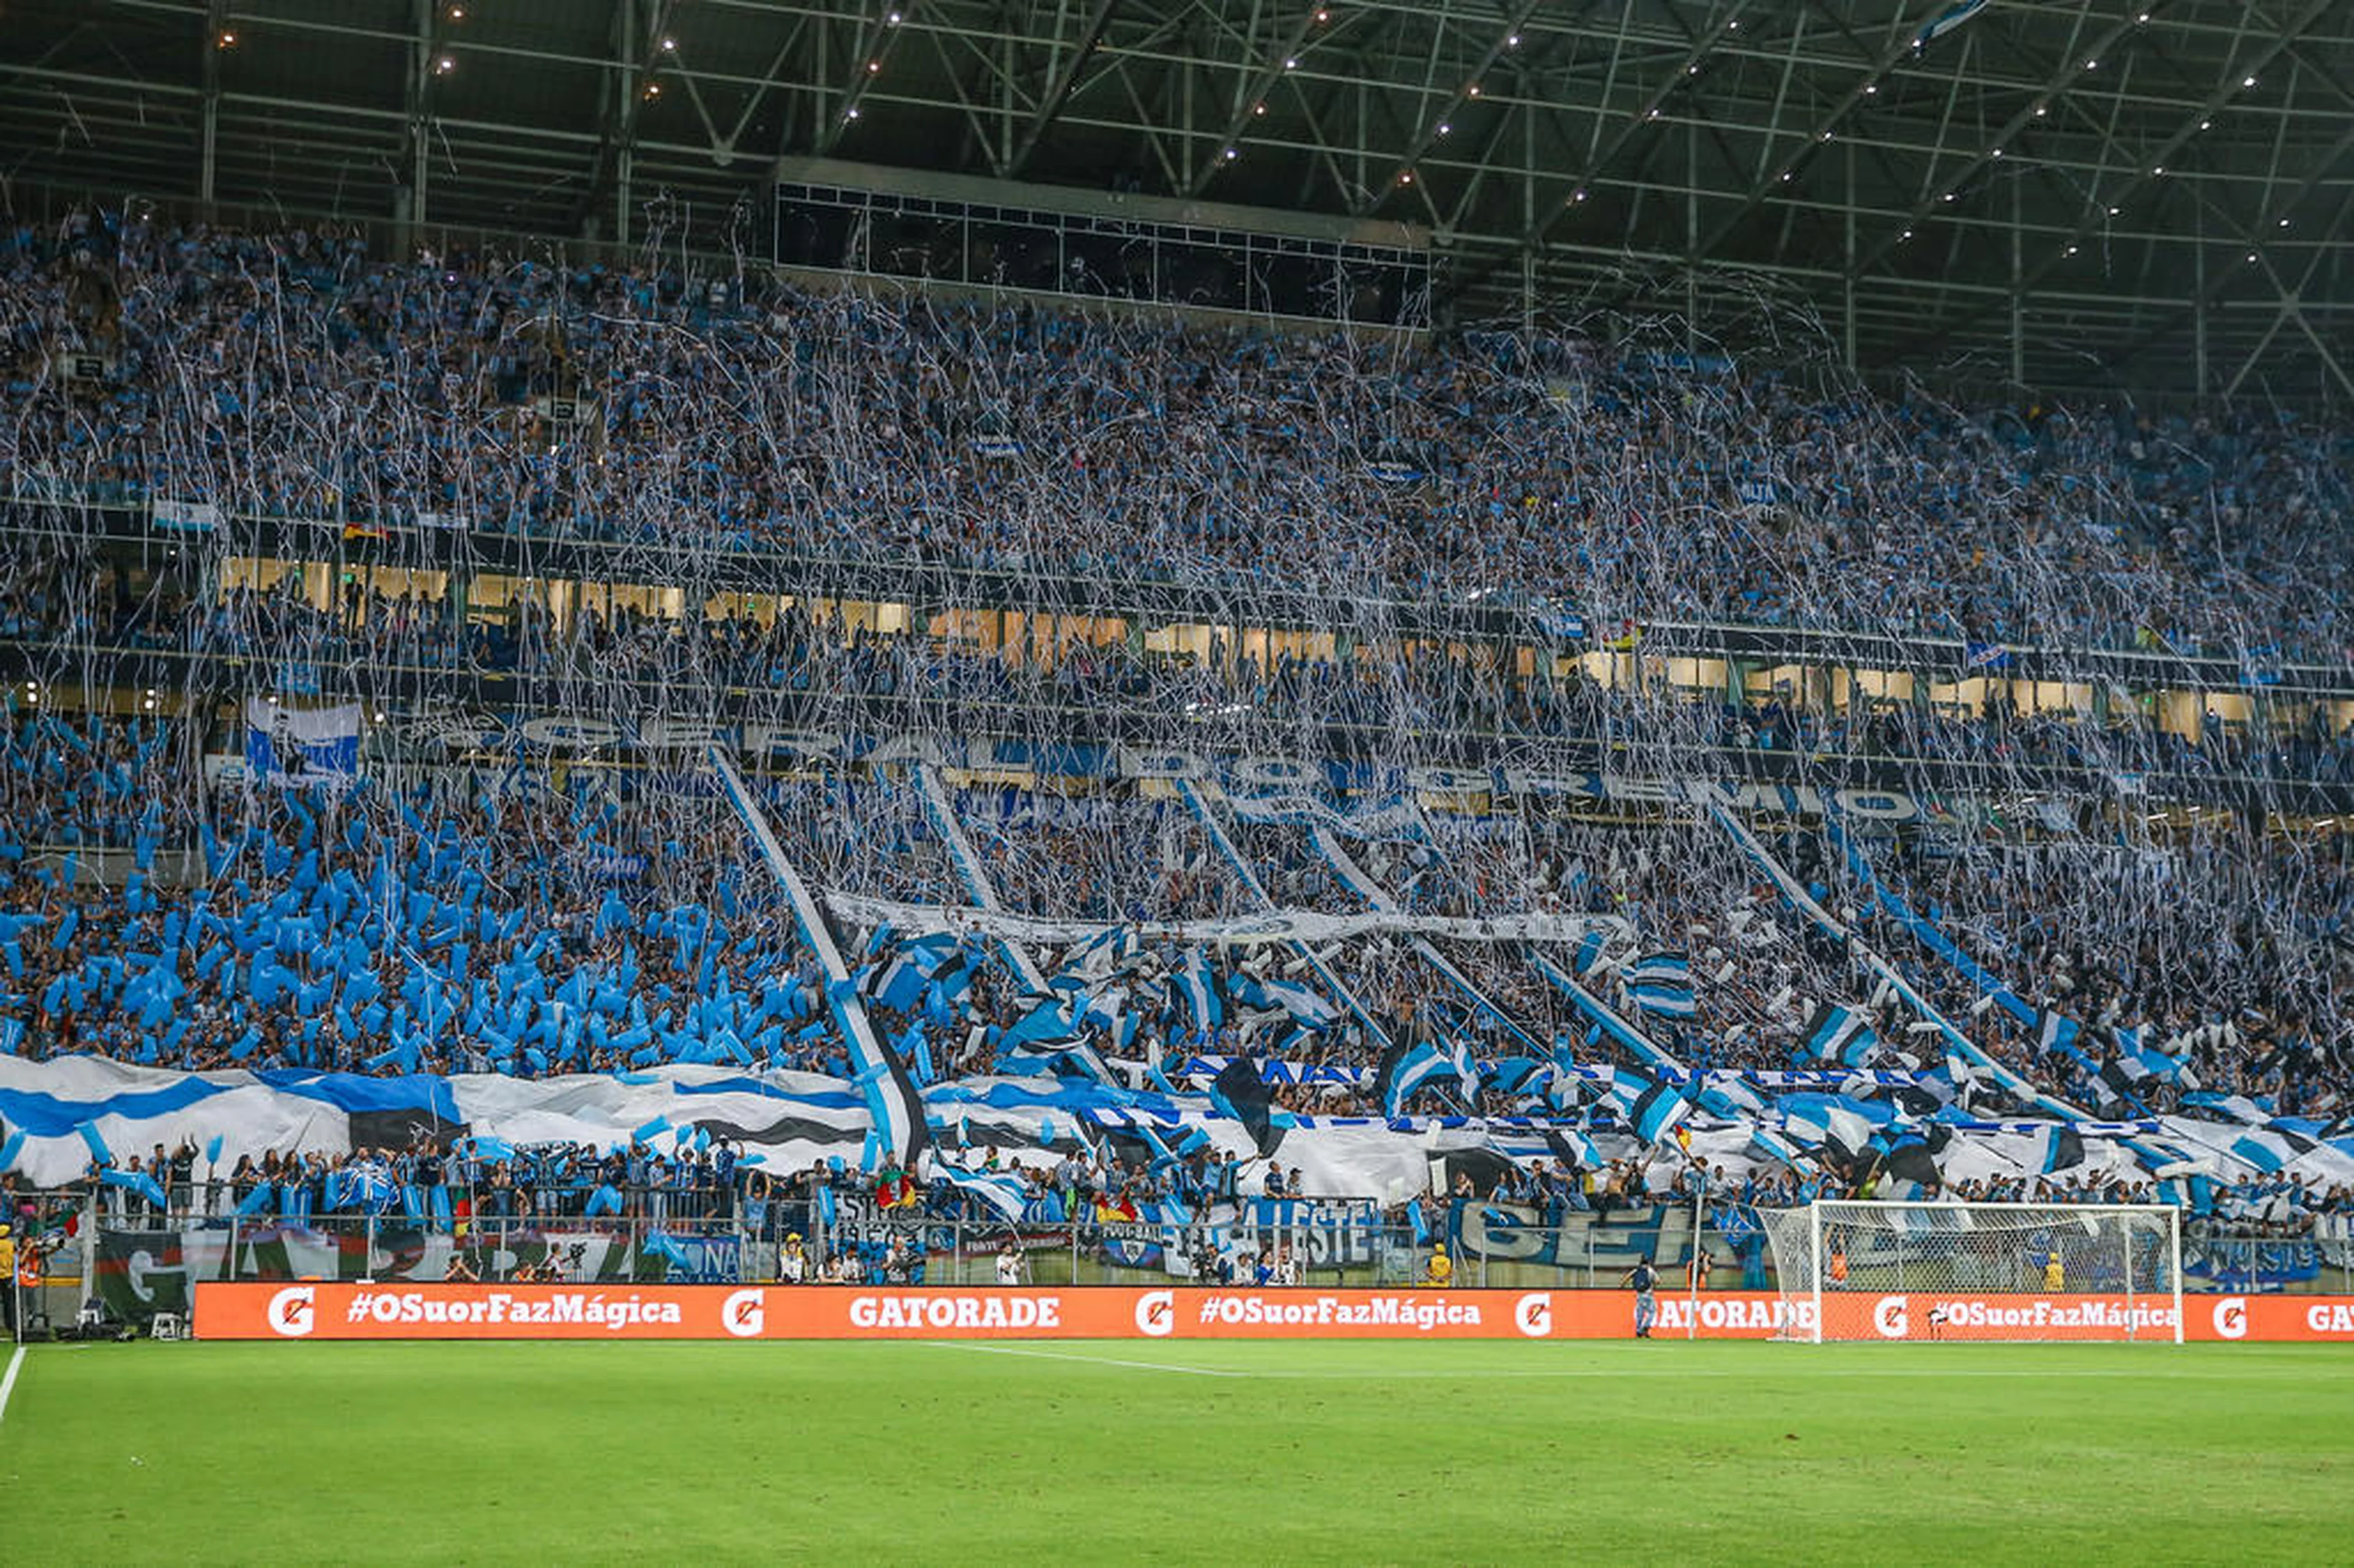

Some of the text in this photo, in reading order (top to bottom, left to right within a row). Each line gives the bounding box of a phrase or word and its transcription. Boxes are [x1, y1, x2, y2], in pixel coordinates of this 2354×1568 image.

[269, 1287, 314, 1336] G
[348, 1293, 682, 1330] #OSuorFazMágica
[722, 1290, 764, 1336] G
[850, 1297, 1060, 1328] GATORADE
[1135, 1291, 1173, 1336] G
[1200, 1295, 1482, 1330] #OSuorFazMágica
[1515, 1293, 1552, 1336] G
[2213, 1297, 2247, 1338] G
[2307, 1305, 2354, 1331] GA
